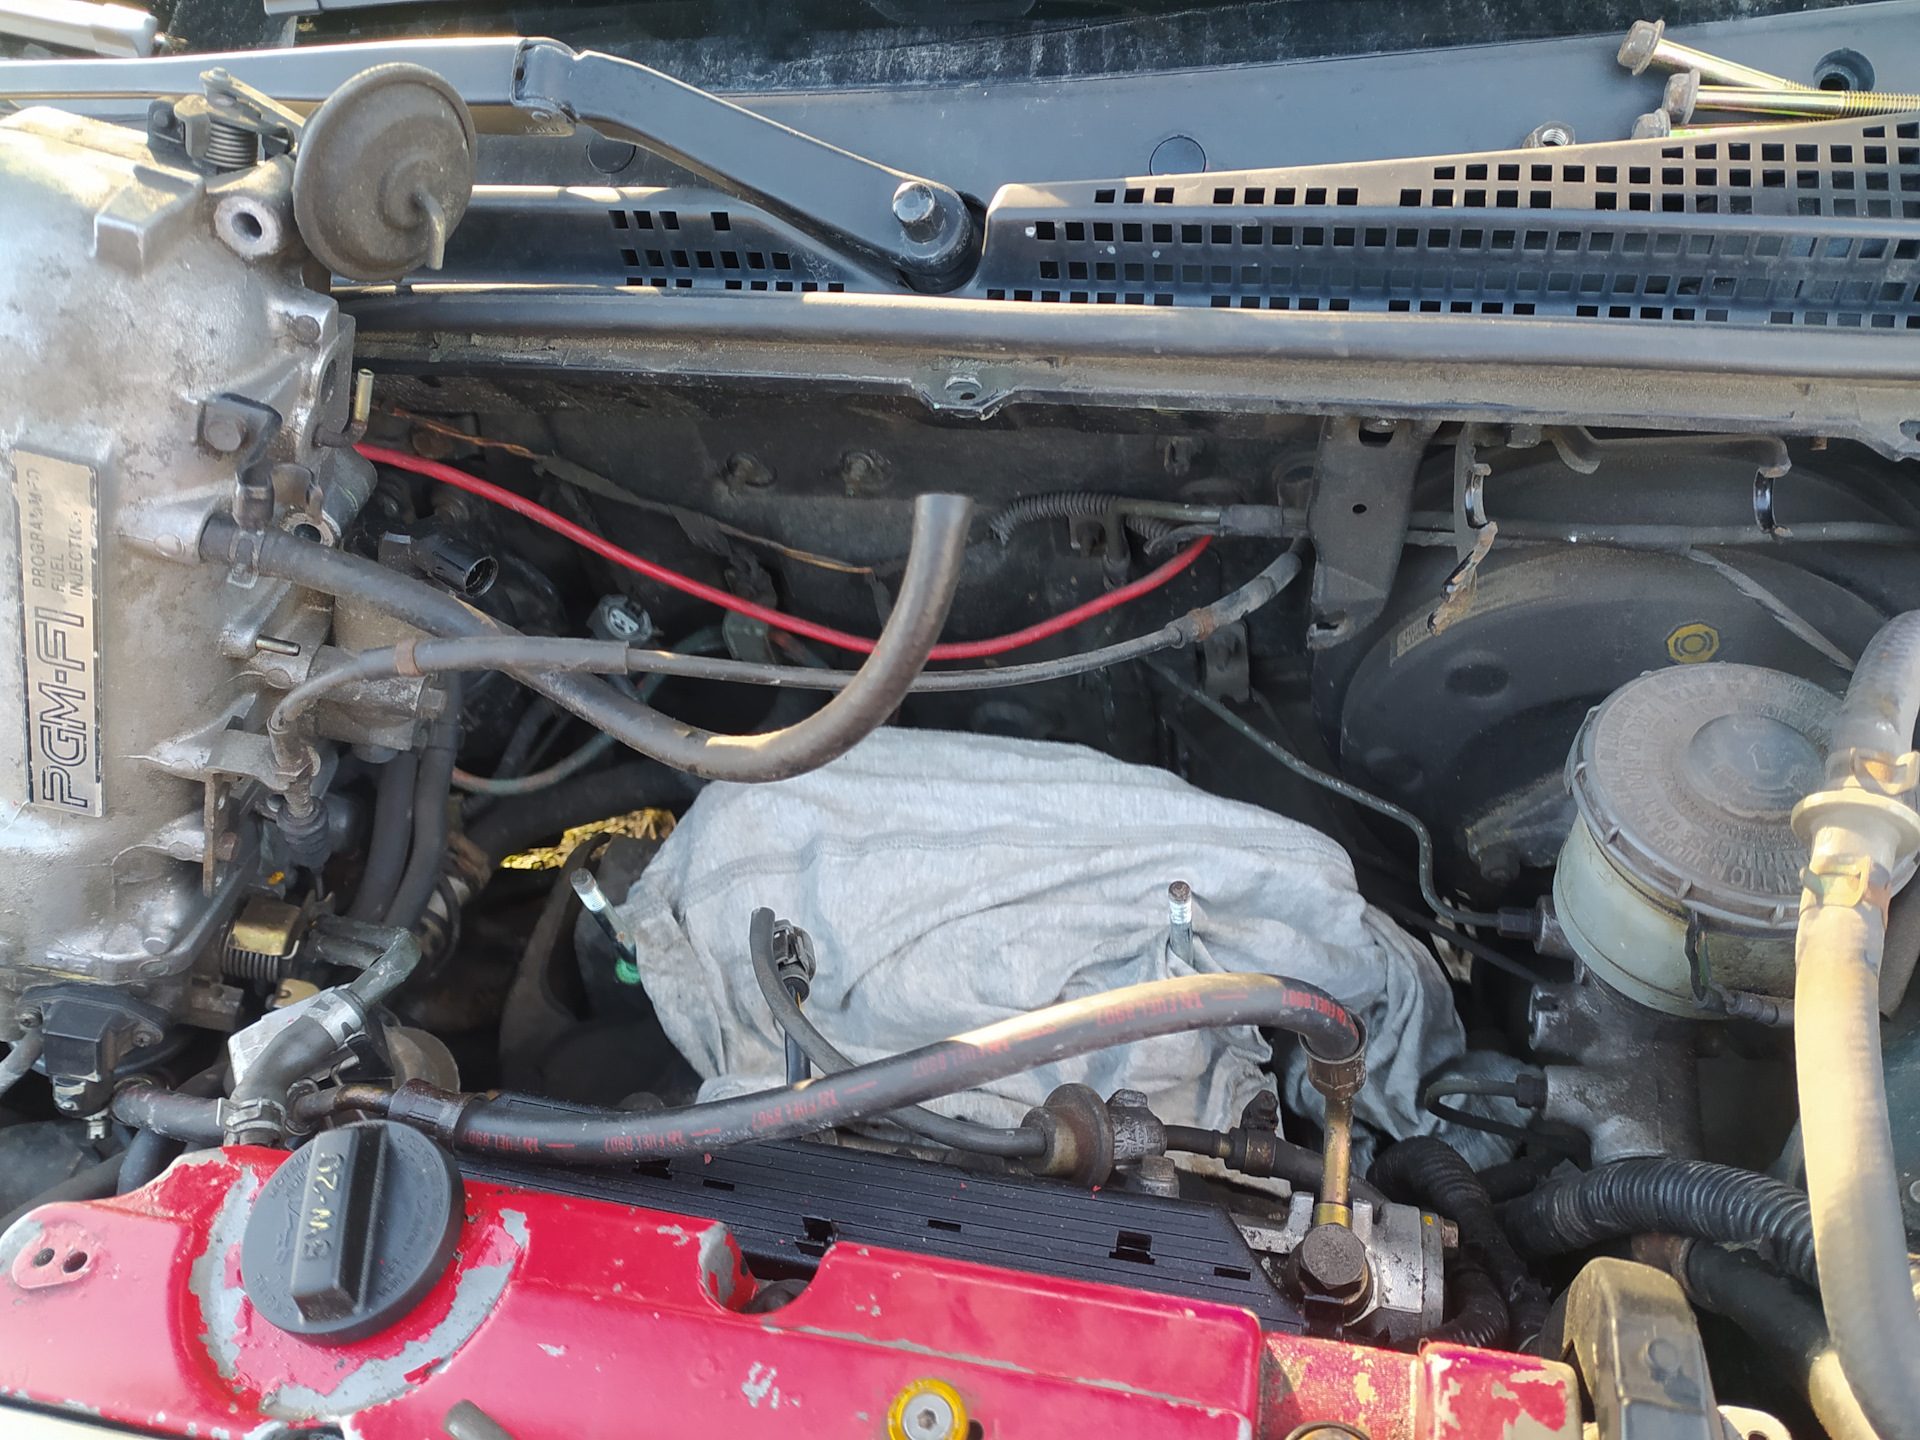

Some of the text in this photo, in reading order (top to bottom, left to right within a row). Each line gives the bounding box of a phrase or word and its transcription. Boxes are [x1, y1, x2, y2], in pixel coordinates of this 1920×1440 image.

[50, 553, 66, 593] FUEL
[33, 606, 88, 808] PGM-FI
[635, 1132, 665, 1150] FUEL
[302, 1150, 345, 1263] 5W-20
